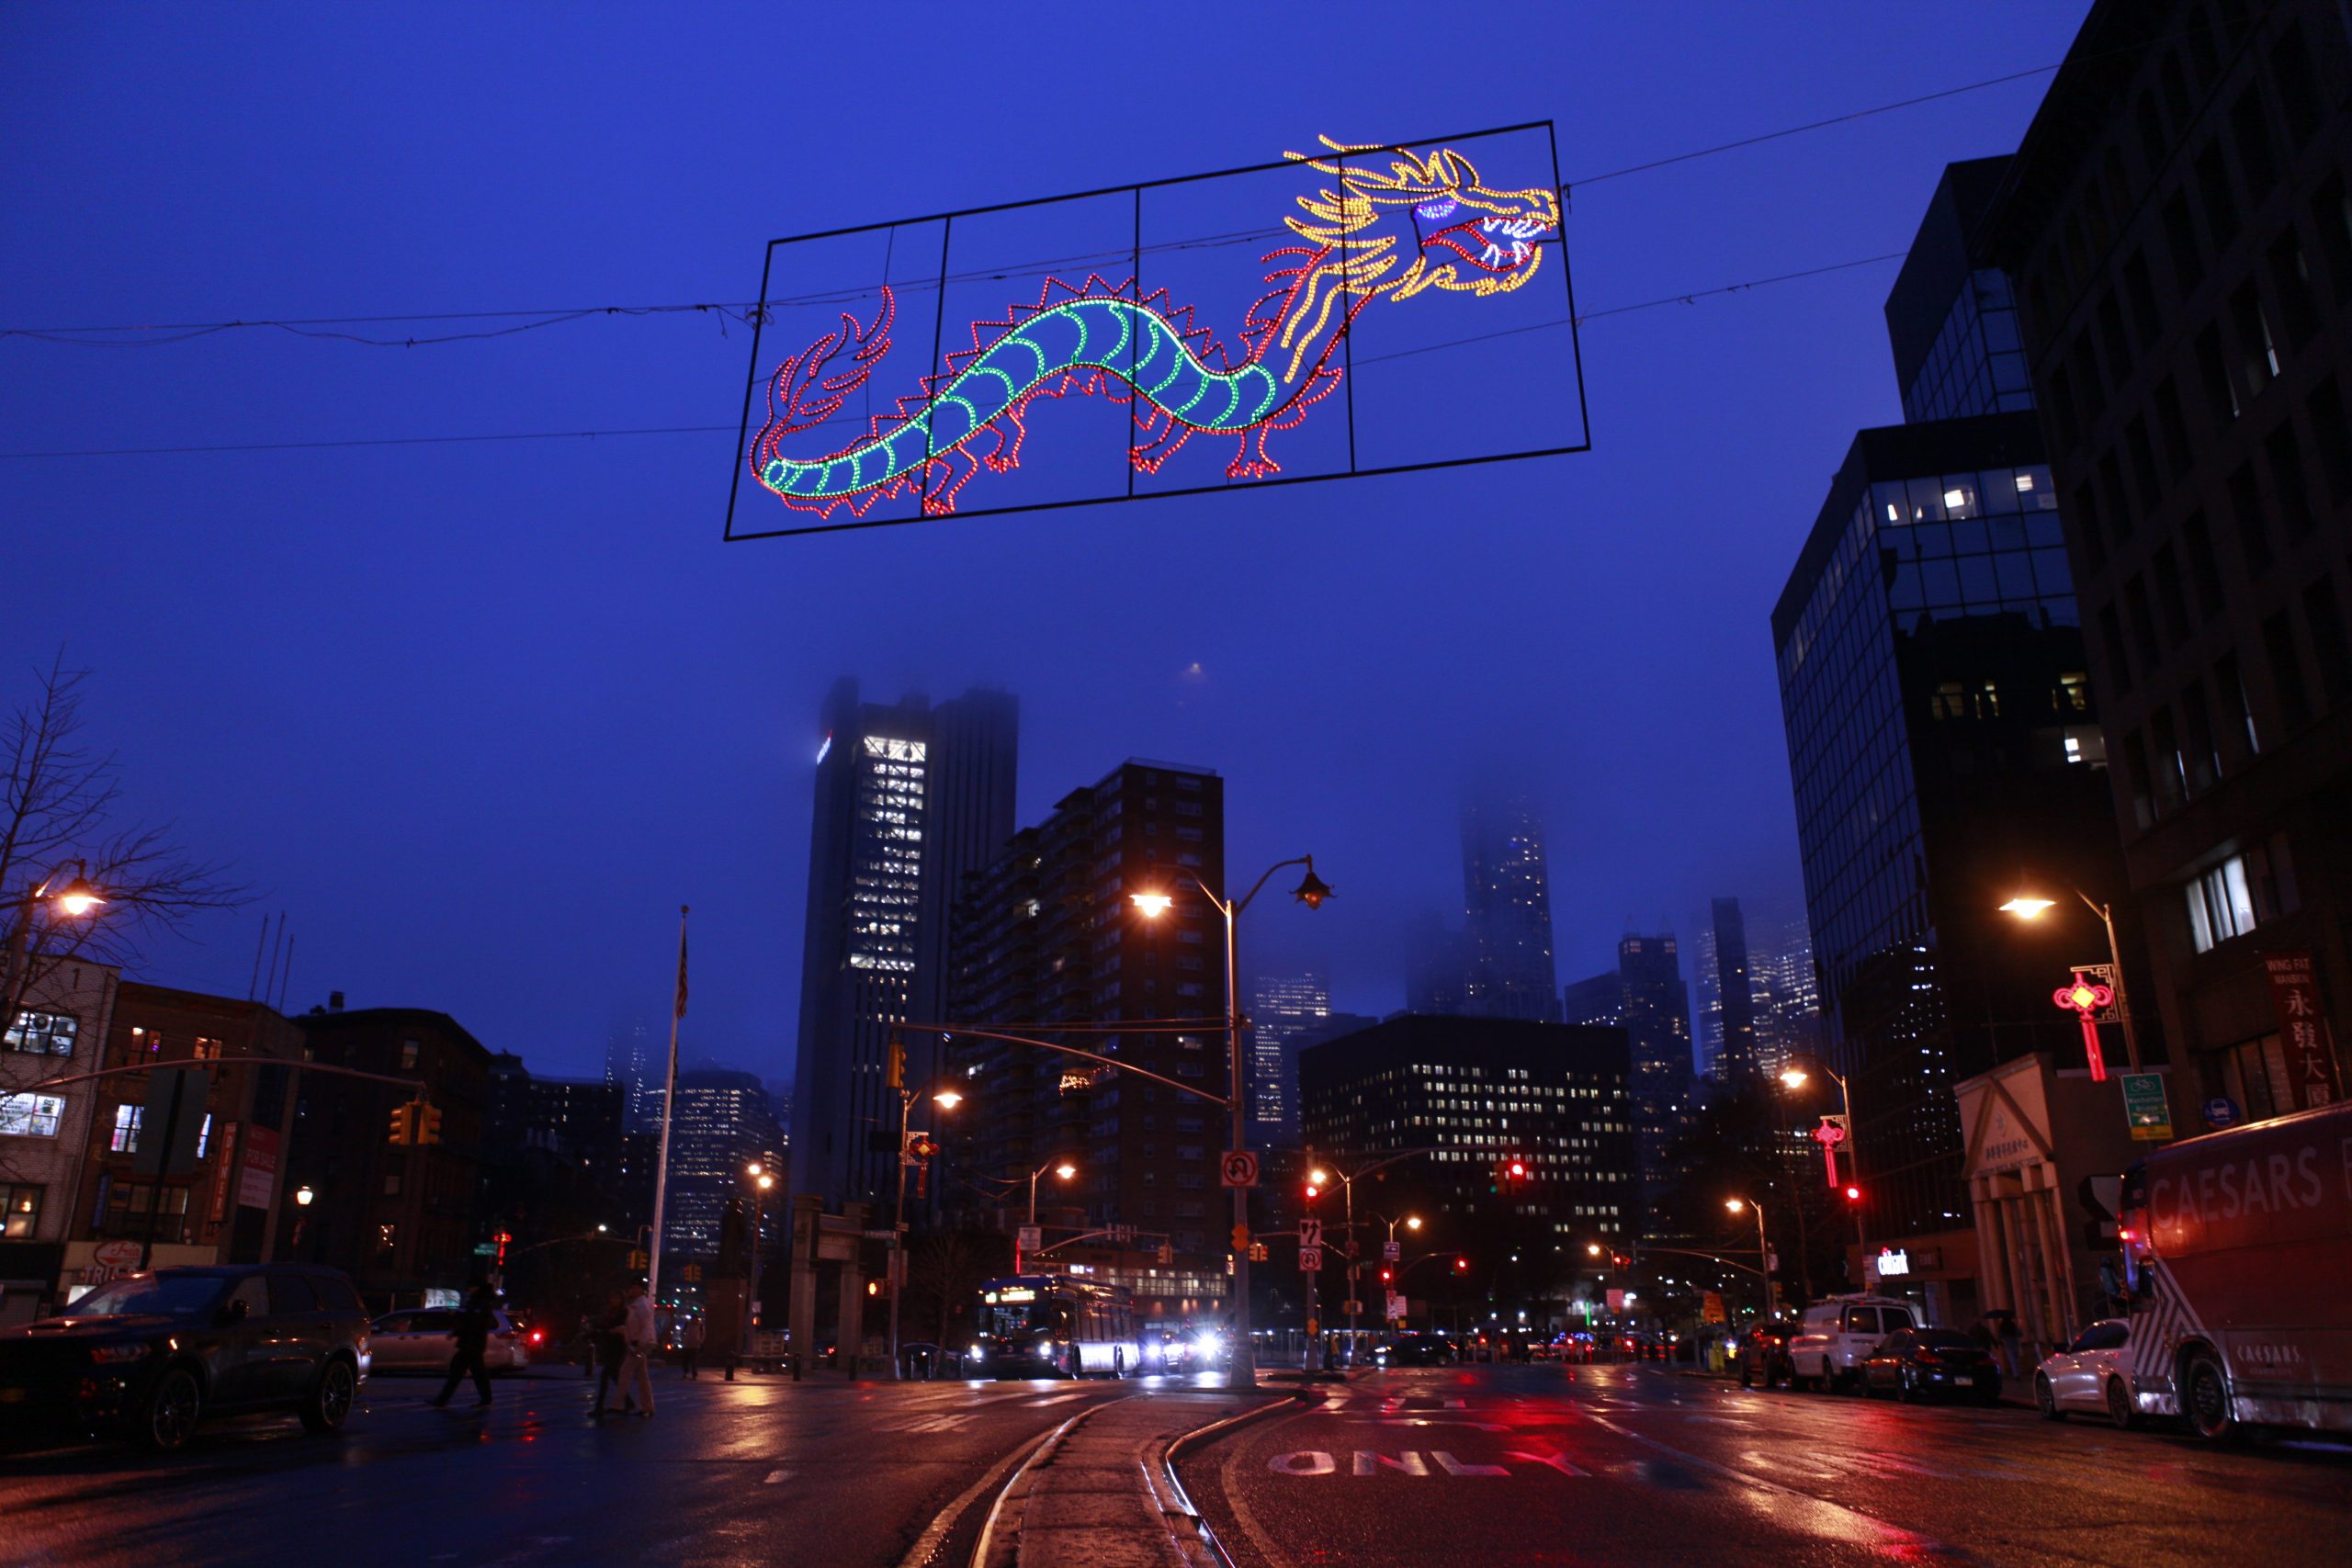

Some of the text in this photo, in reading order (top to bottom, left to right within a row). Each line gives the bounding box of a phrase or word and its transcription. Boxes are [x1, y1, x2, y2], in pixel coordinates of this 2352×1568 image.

[2266, 958, 2311, 972] WING FAT
[2274, 974, 2310, 985] MANSION
[246, 1147, 277, 1169] FOR SALE
[216, 1134, 233, 1212] DINER
[2151, 1146, 2323, 1229] CAESARS
[2236, 1344, 2301, 1363] CAESARS
[1266, 1450, 1593, 1477] ONLY
